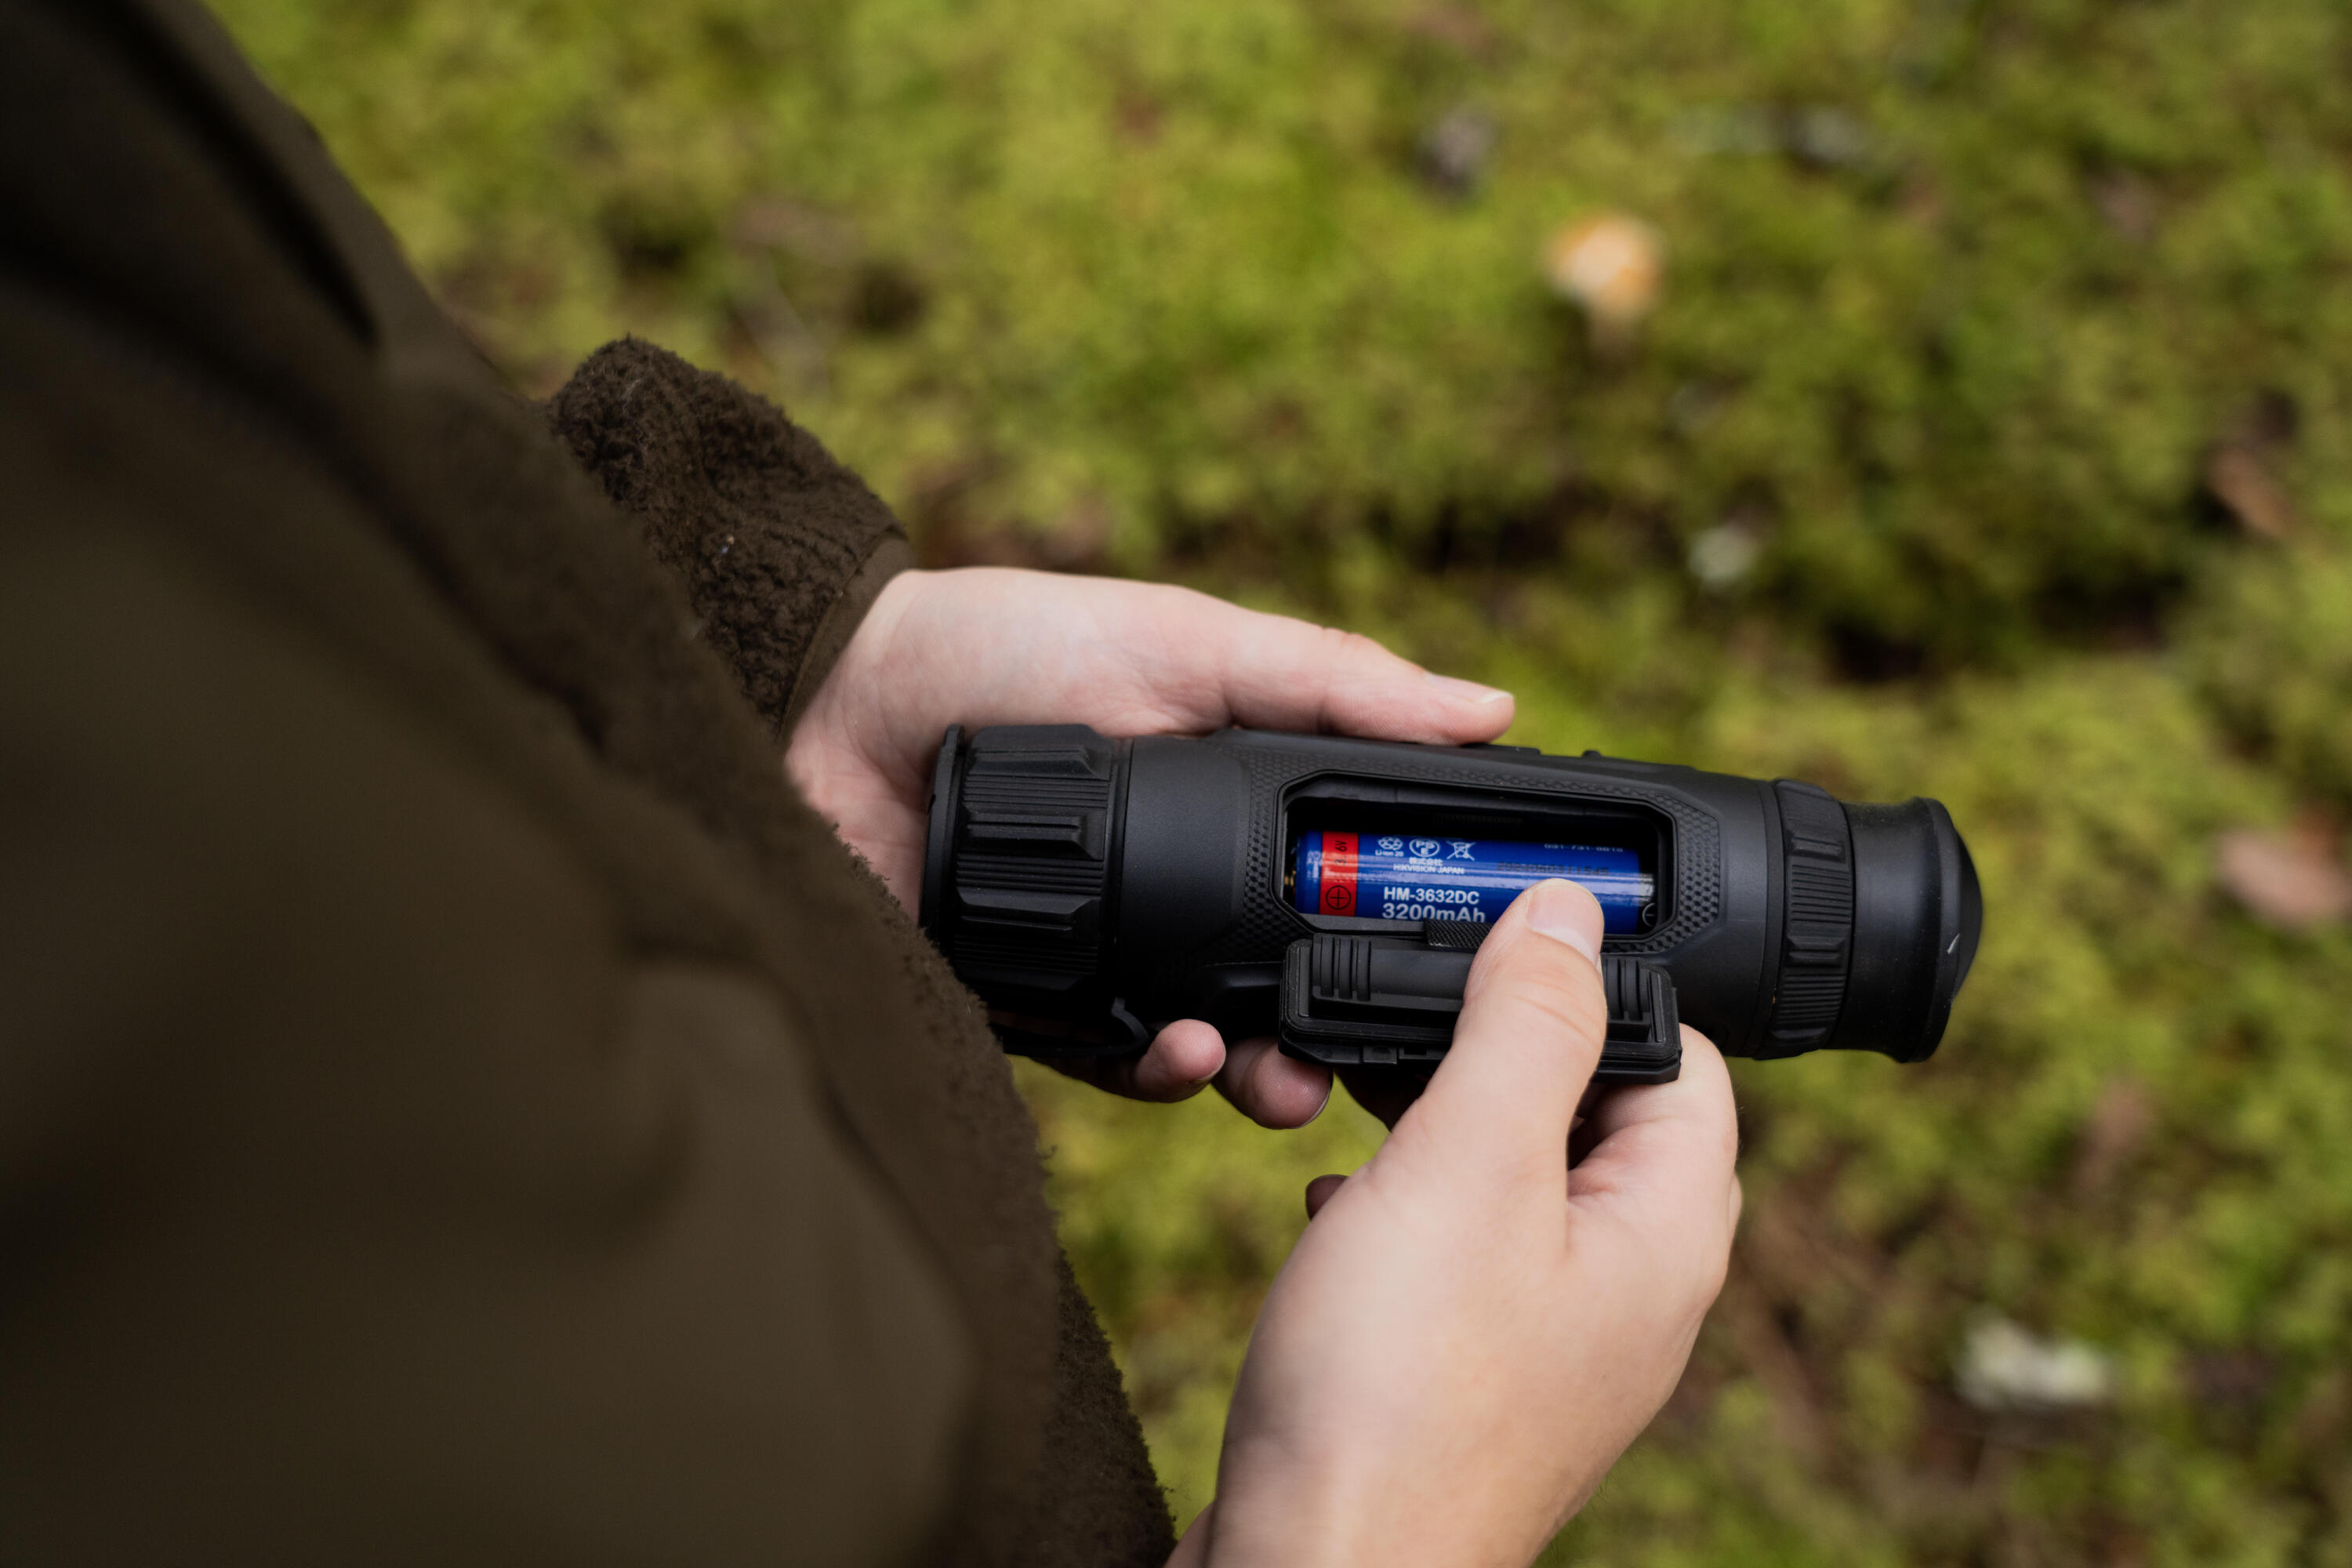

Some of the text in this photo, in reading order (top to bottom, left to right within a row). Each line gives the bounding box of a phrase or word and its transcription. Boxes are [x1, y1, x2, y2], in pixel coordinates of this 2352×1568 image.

[1393, 864, 1465, 875] HIKVISION JAPAN
[1383, 886, 1480, 905] HM-3632DC
[1382, 902, 1486, 923] 3200mAh
